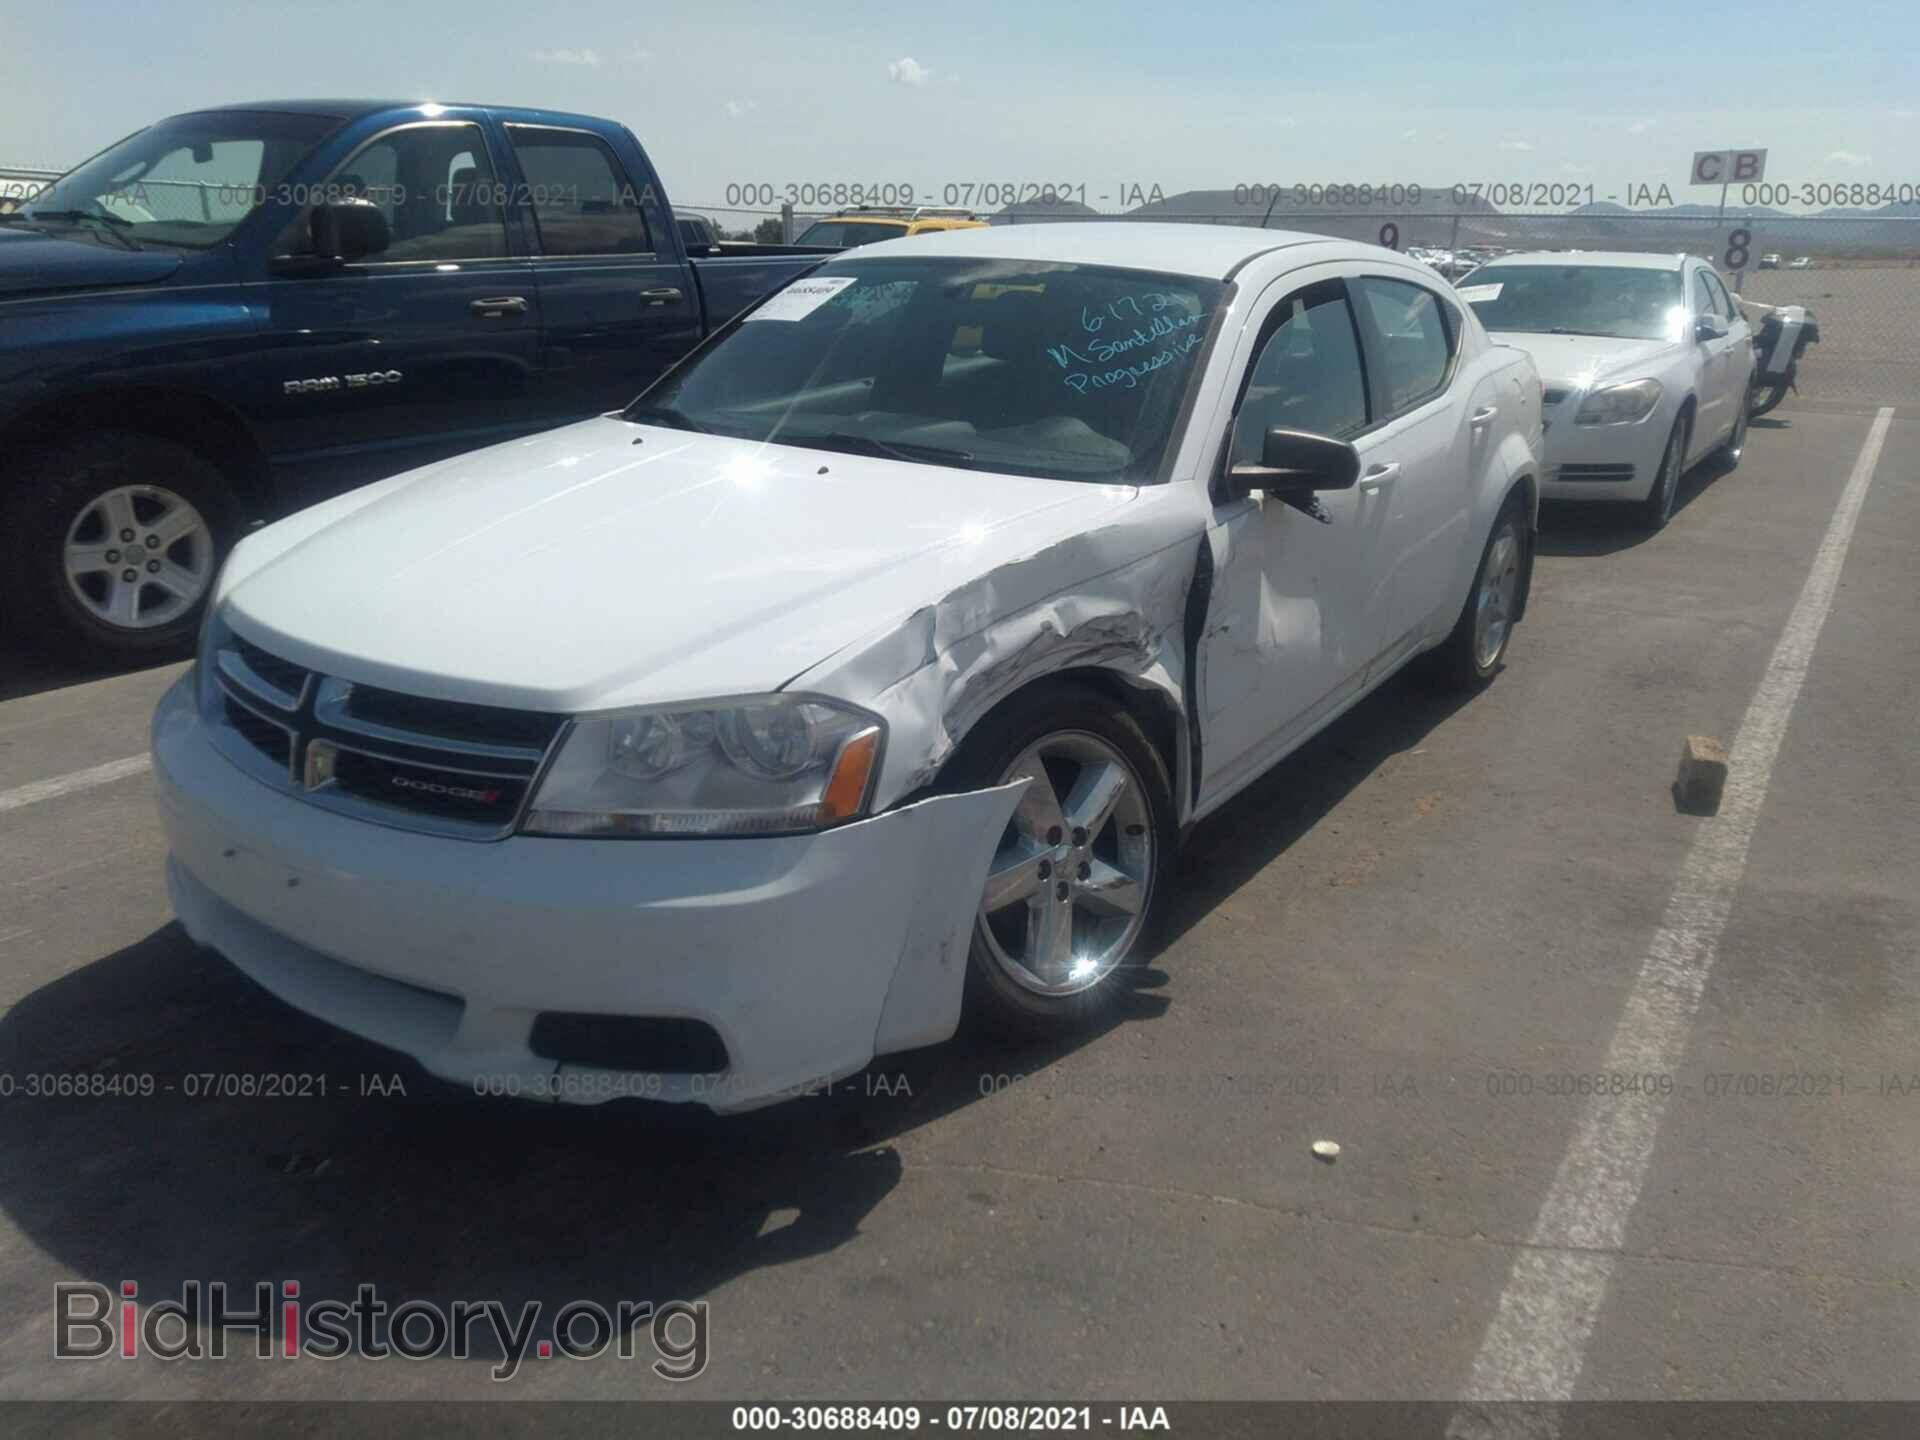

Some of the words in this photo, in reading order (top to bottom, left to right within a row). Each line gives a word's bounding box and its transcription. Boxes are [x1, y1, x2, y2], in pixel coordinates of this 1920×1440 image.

[1696, 154, 1721, 181] C
[1734, 153, 1760, 181] B
[1379, 222, 1399, 251] 9
[1724, 228, 1752, 270] 8
[344, 369, 403, 389] 1500
[391, 776, 487, 801] DODGE
